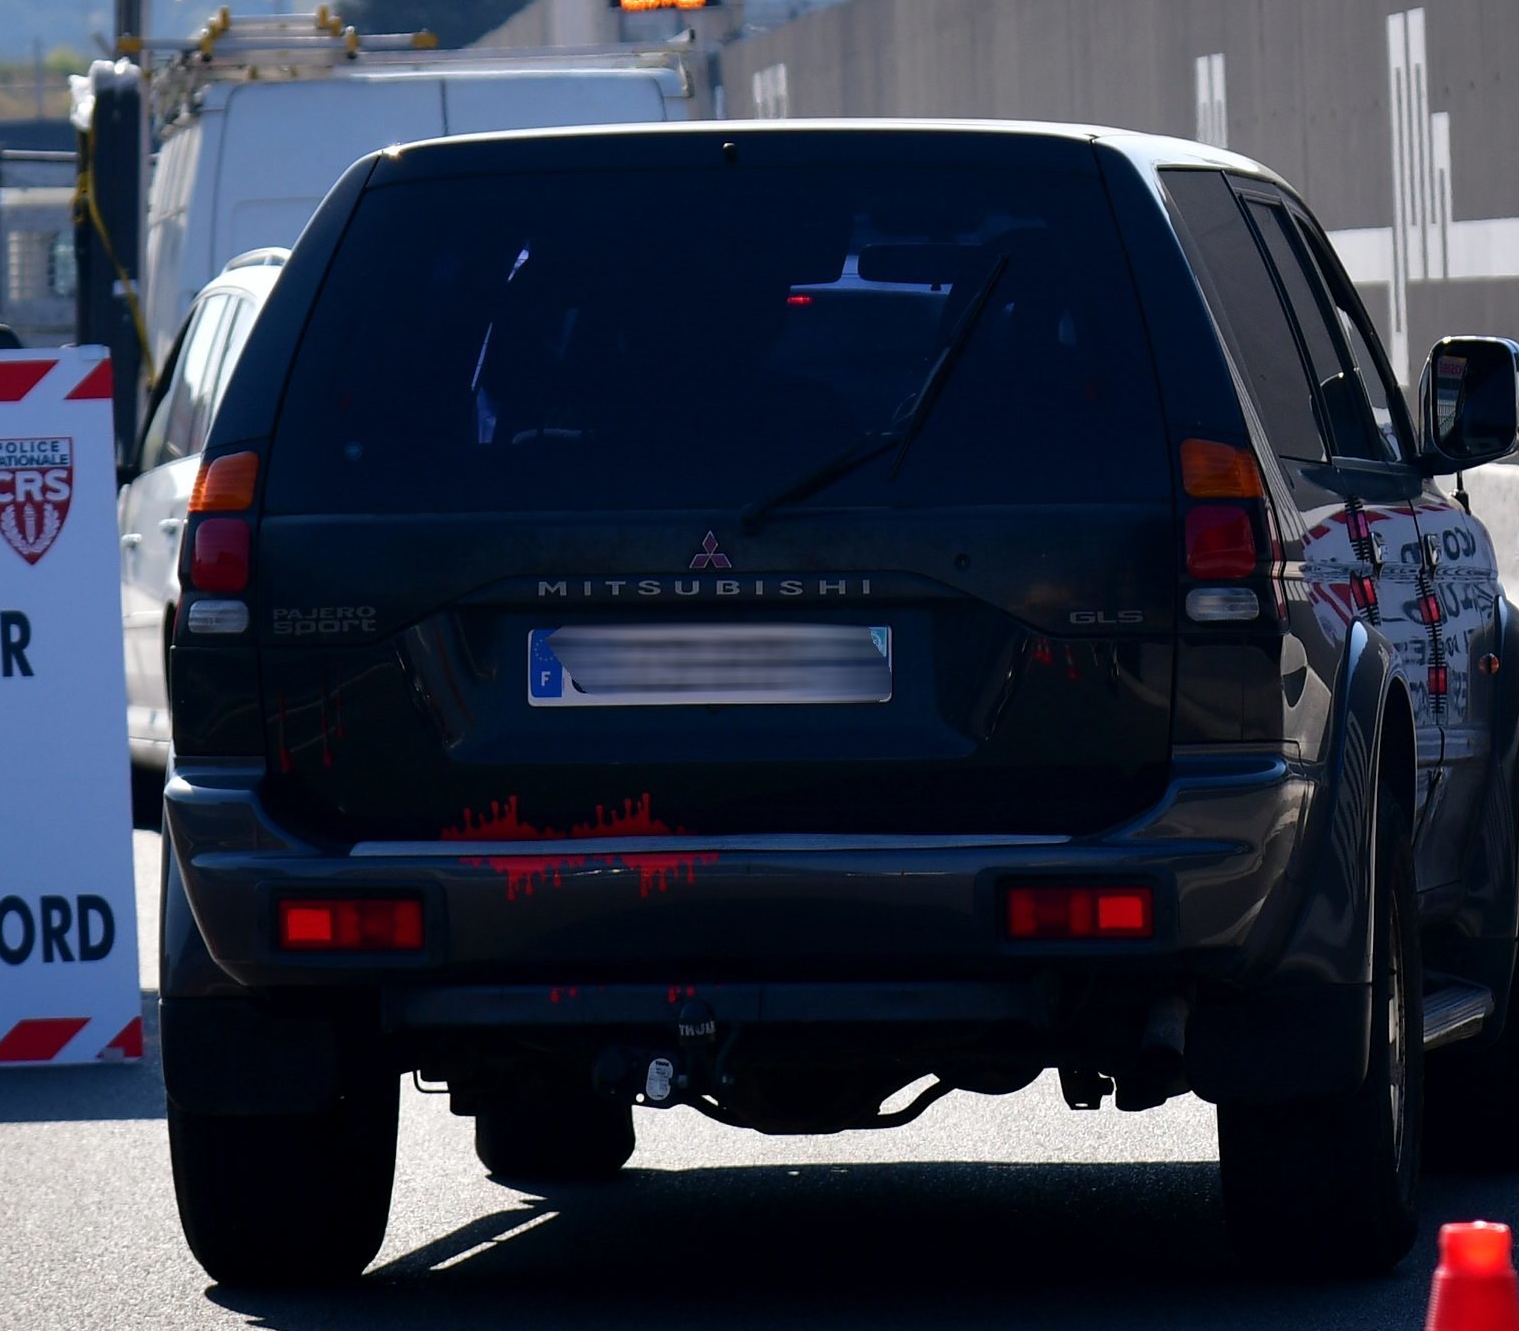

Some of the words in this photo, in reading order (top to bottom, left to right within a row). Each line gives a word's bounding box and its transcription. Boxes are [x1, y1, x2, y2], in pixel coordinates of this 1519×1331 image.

[537, 579, 871, 597] MITSUBISHI
[272, 606, 377, 620] PAJERO
[1069, 610, 1144, 624] GLS
[540, 671, 551, 687] F
